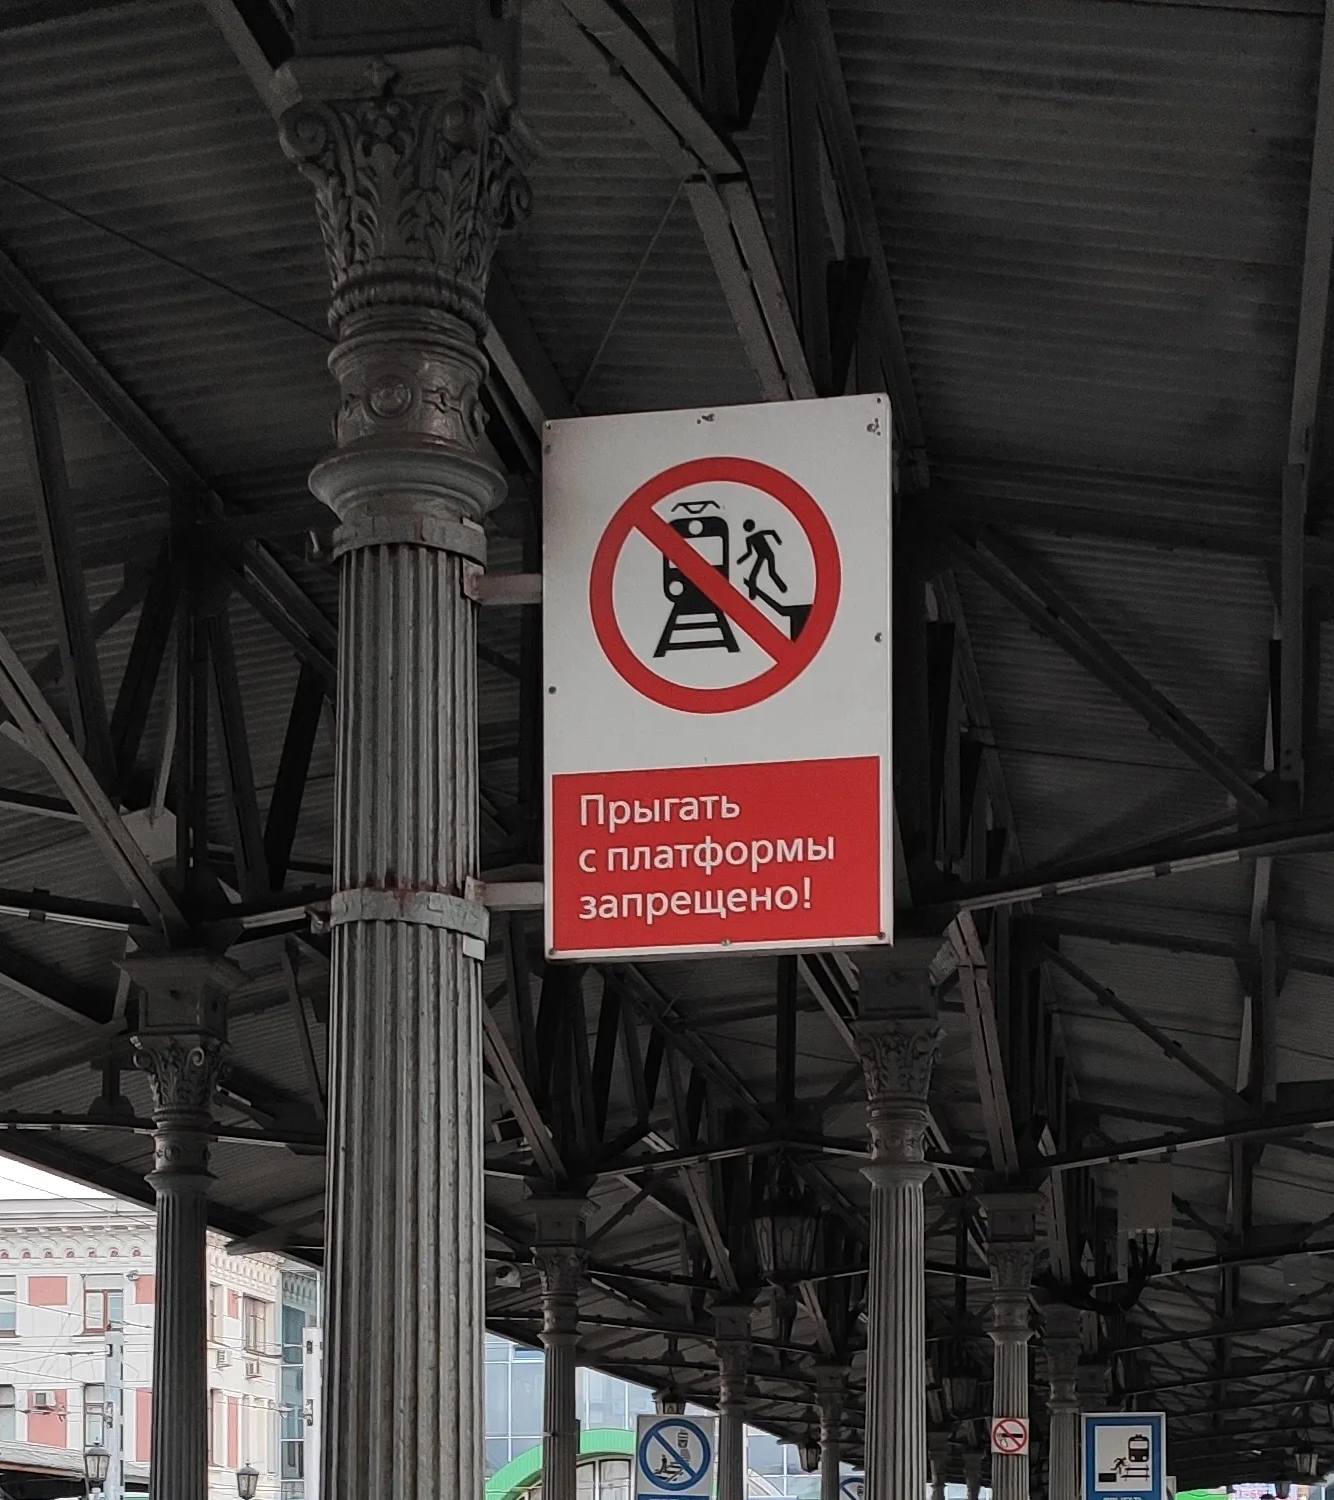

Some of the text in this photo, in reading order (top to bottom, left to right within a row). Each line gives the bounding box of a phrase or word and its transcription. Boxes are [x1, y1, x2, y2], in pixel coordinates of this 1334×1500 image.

[578, 793, 741, 833] Прыгать
[578, 835, 835, 876] с платформы
[578, 876, 812, 925] запрещено!
